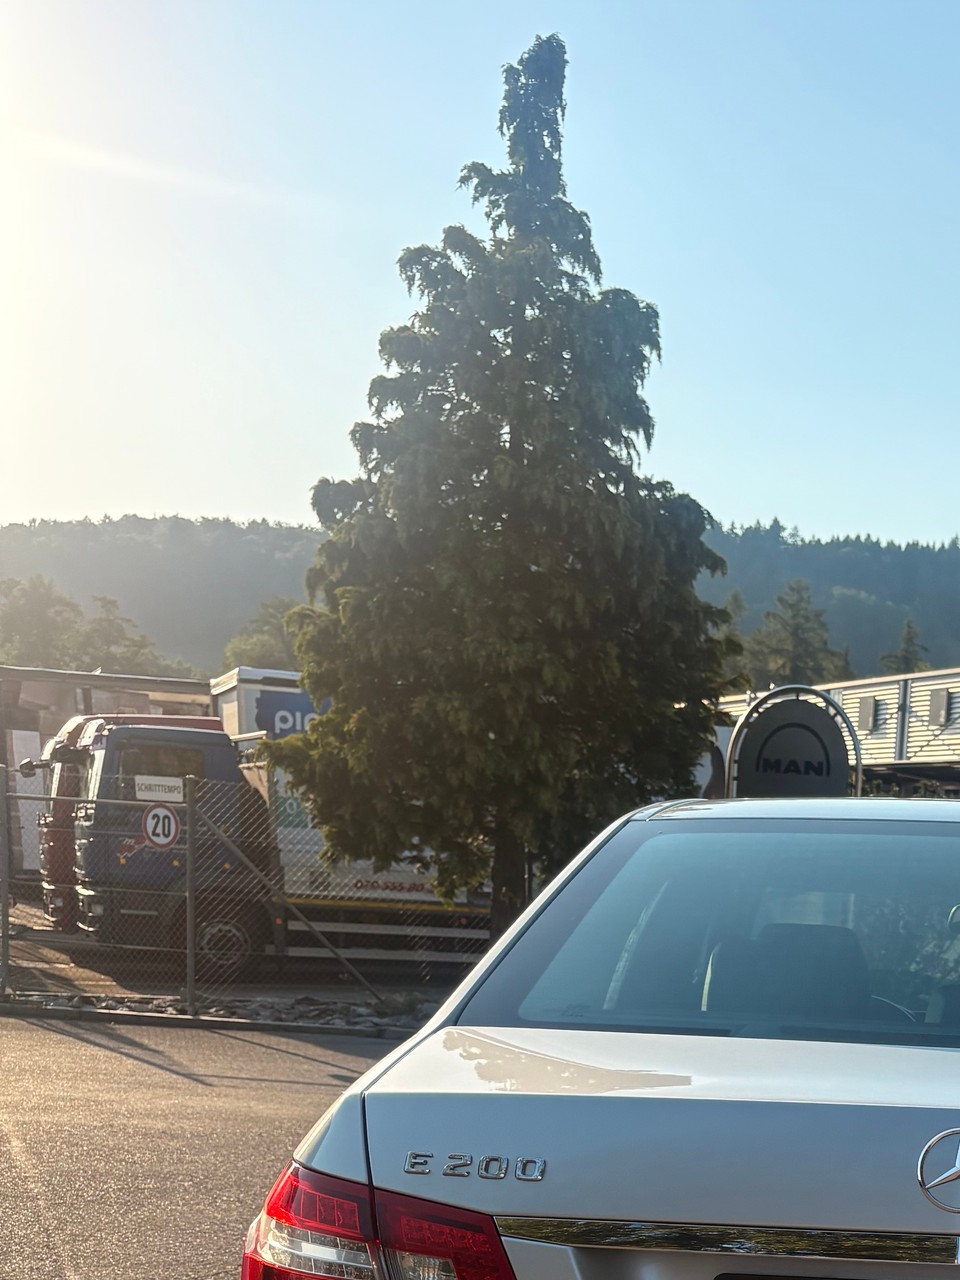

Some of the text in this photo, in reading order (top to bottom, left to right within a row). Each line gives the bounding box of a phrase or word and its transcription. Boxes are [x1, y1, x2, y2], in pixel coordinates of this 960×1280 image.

[762, 758, 824, 776] MAN
[151, 813, 171, 838] 20
[404, 1150, 546, 1182] E 200
